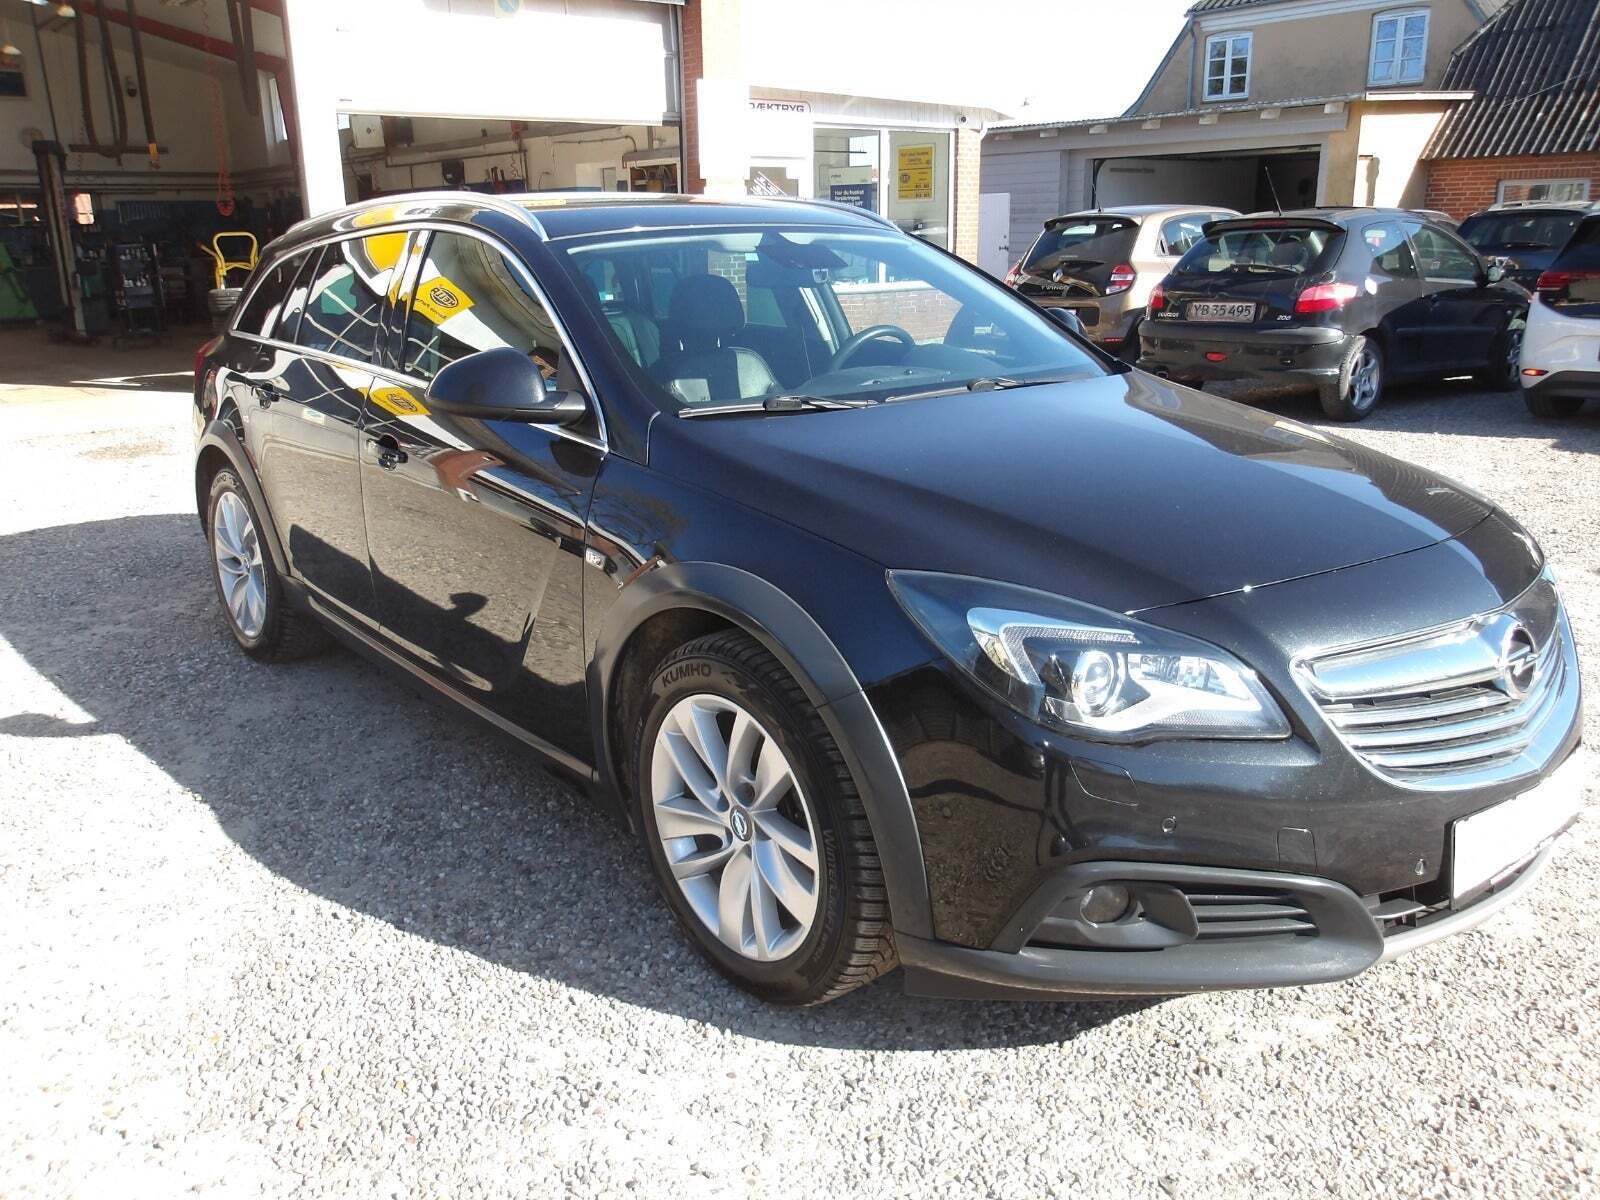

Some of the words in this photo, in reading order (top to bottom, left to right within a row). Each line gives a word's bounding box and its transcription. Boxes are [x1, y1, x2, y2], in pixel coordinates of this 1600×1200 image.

[1194, 304, 1210, 316] YB
[1211, 304, 1226, 317] 35
[1228, 305, 1252, 317] 495
[662, 663, 712, 687] KUMHO
